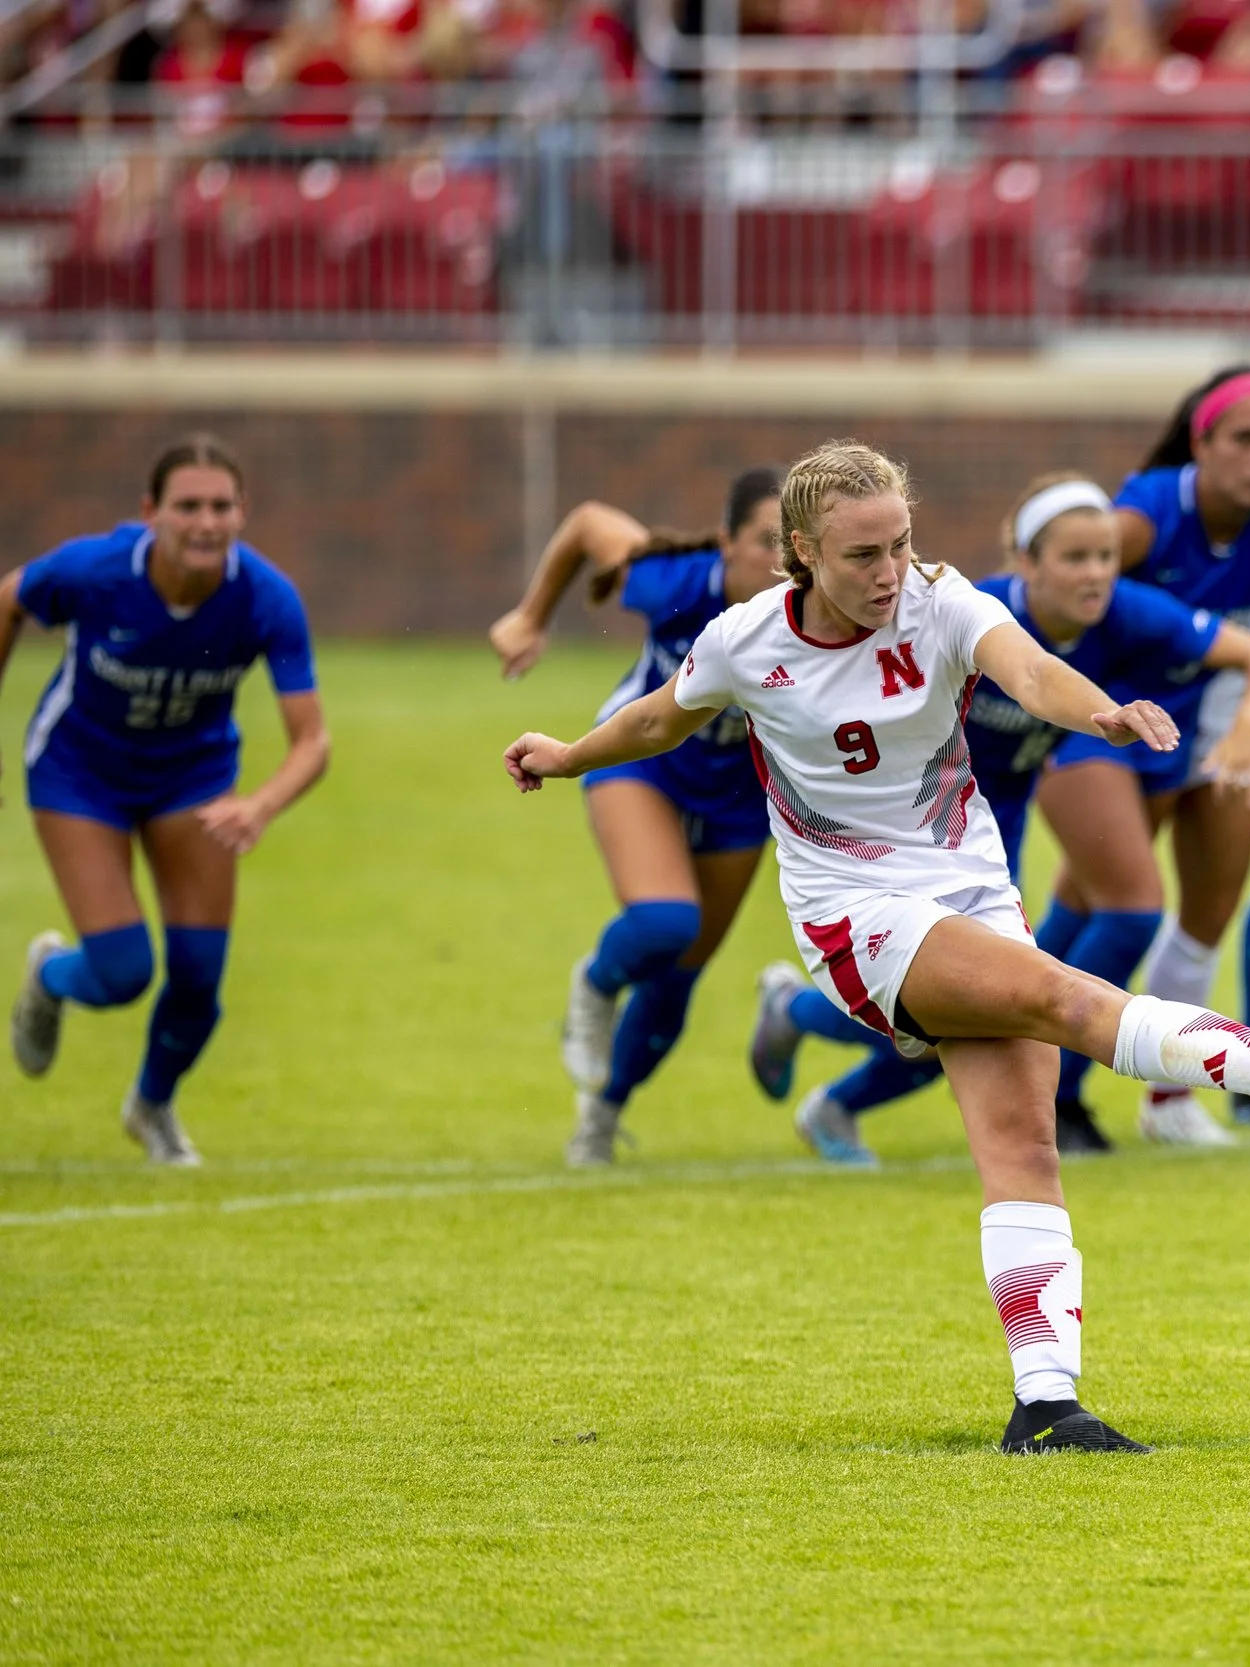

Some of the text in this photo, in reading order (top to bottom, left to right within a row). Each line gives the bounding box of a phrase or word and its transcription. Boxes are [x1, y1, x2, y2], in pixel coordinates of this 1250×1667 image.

[761, 679, 795, 688] adidas
[876, 639, 927, 699] N
[833, 719, 880, 775] 9
[869, 929, 892, 961] adidas
